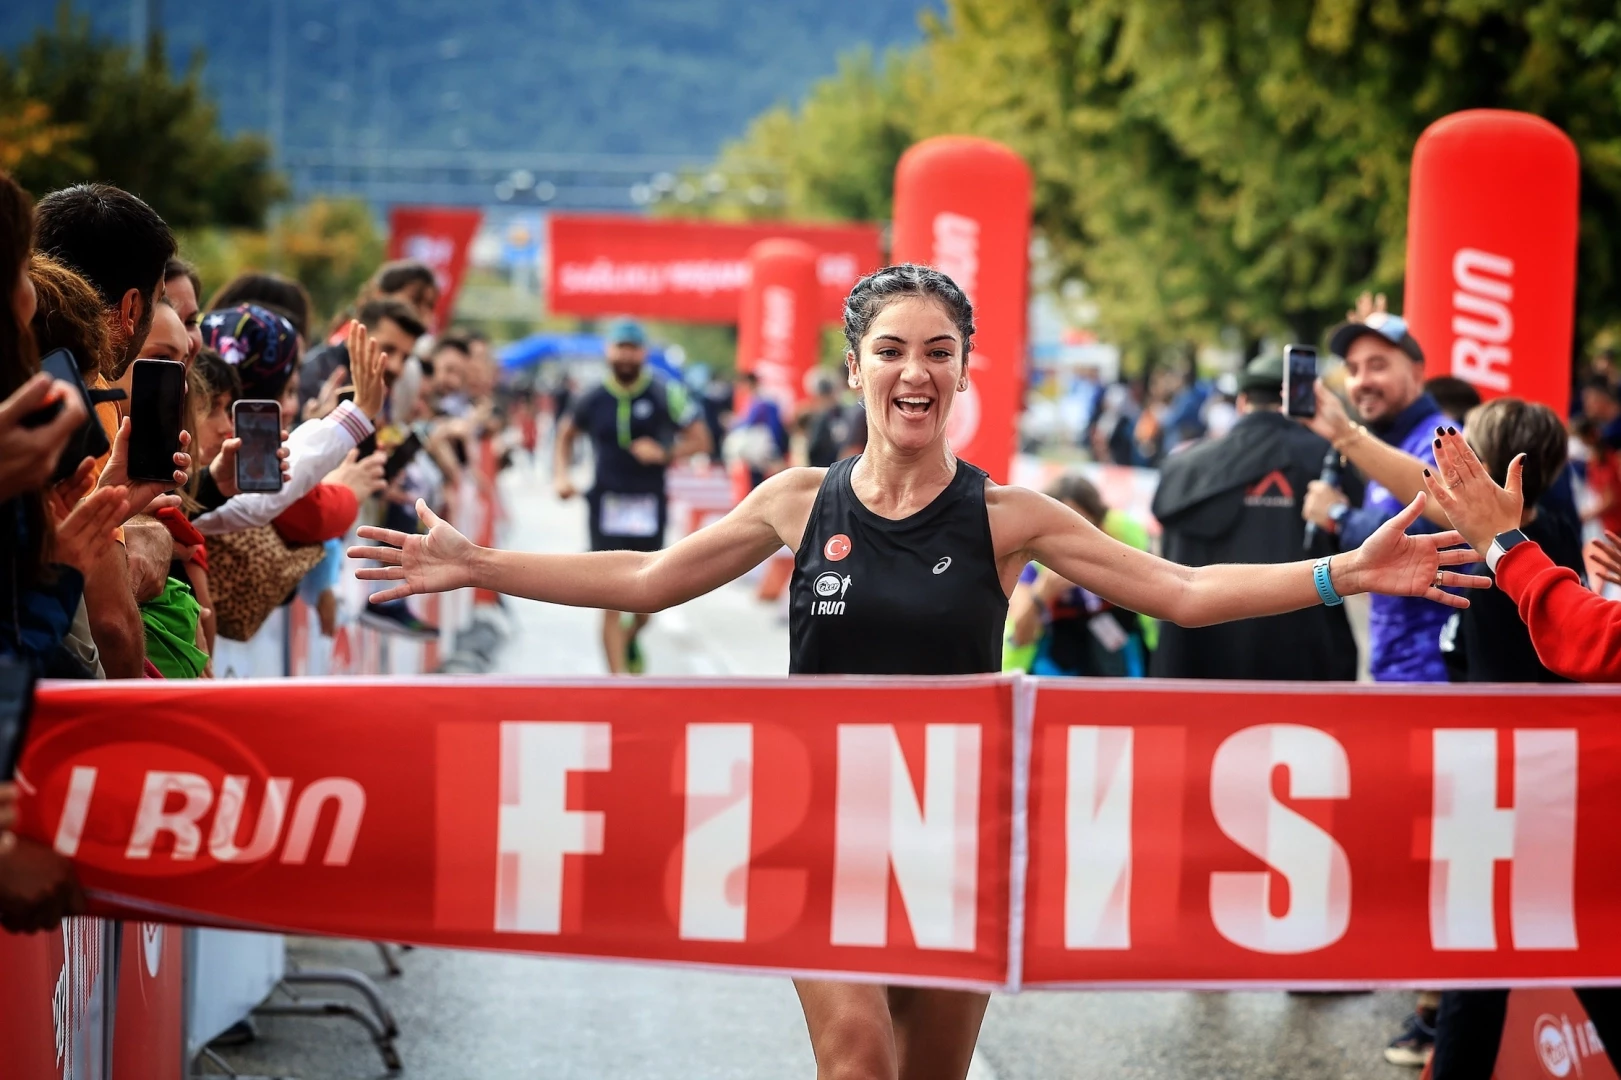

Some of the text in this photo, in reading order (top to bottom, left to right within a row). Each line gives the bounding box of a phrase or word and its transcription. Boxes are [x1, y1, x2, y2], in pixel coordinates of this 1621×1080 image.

[1452, 247, 1514, 392] RUN
[811, 601, 846, 616] I RUN
[54, 766, 367, 866] I RUN
[494, 721, 1579, 956] FINISH
